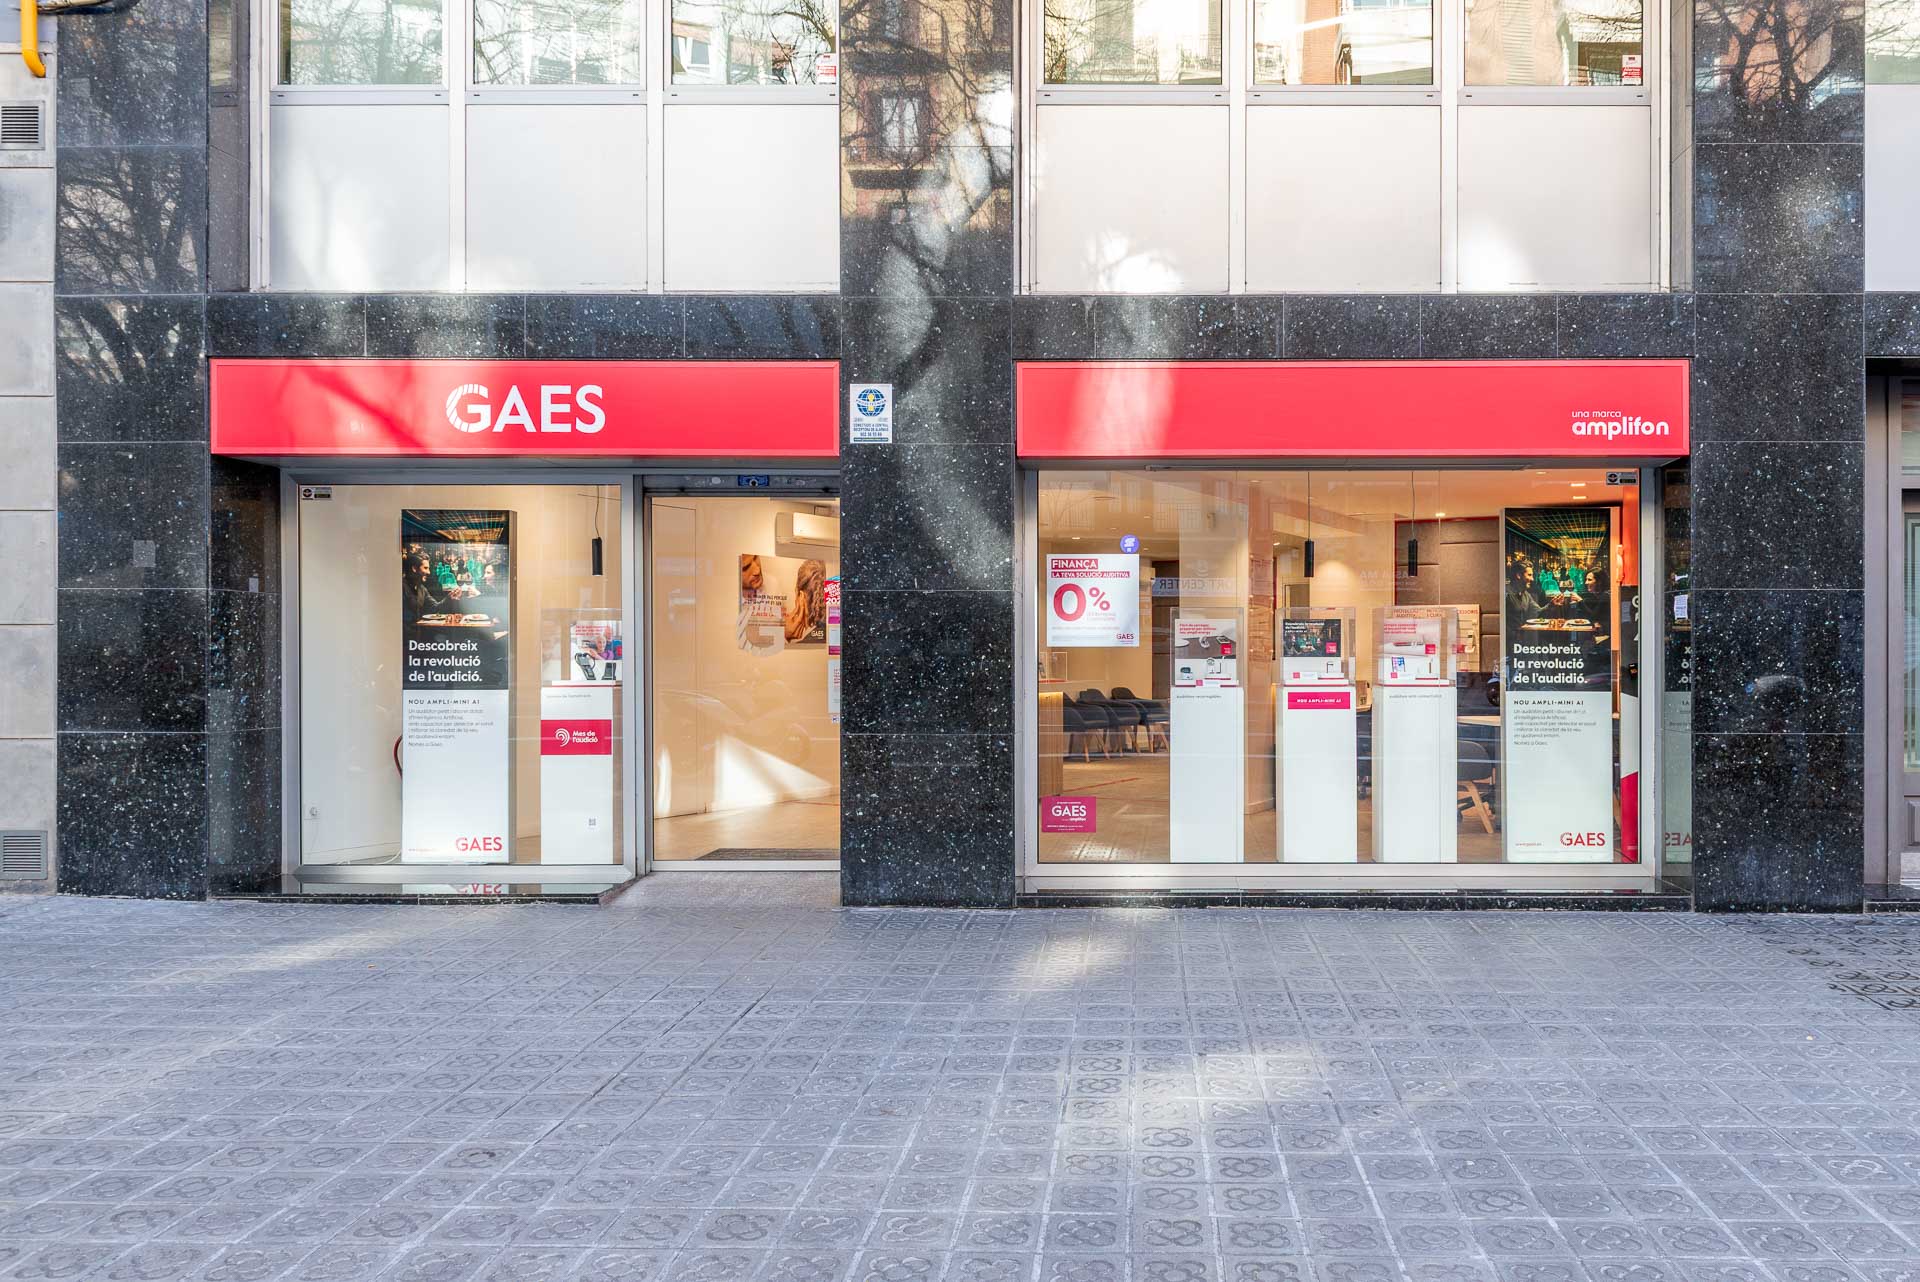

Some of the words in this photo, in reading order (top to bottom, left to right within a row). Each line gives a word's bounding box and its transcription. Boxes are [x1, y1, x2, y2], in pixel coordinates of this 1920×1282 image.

[446, 383, 606, 433] GAES
[1572, 416, 1670, 440] amplifon
[1052, 560, 1098, 570] FINANÇA
[1054, 583, 1110, 622] 0%
[409, 640, 478, 651] Descobreix
[1514, 644, 1581, 654] Descobreix
[409, 656, 420, 666] la
[424, 656, 480, 666] revolució
[1514, 658, 1525, 669] la
[1528, 658, 1584, 669] revolució
[409, 671, 425, 682] de
[428, 671, 482, 682] l'audició.
[1514, 673, 1529, 684] de
[1533, 673, 1588, 684] l'audidió.
[1051, 805, 1087, 817] GAES
[456, 837, 502, 851] GAES
[1560, 832, 1605, 846] GAES
